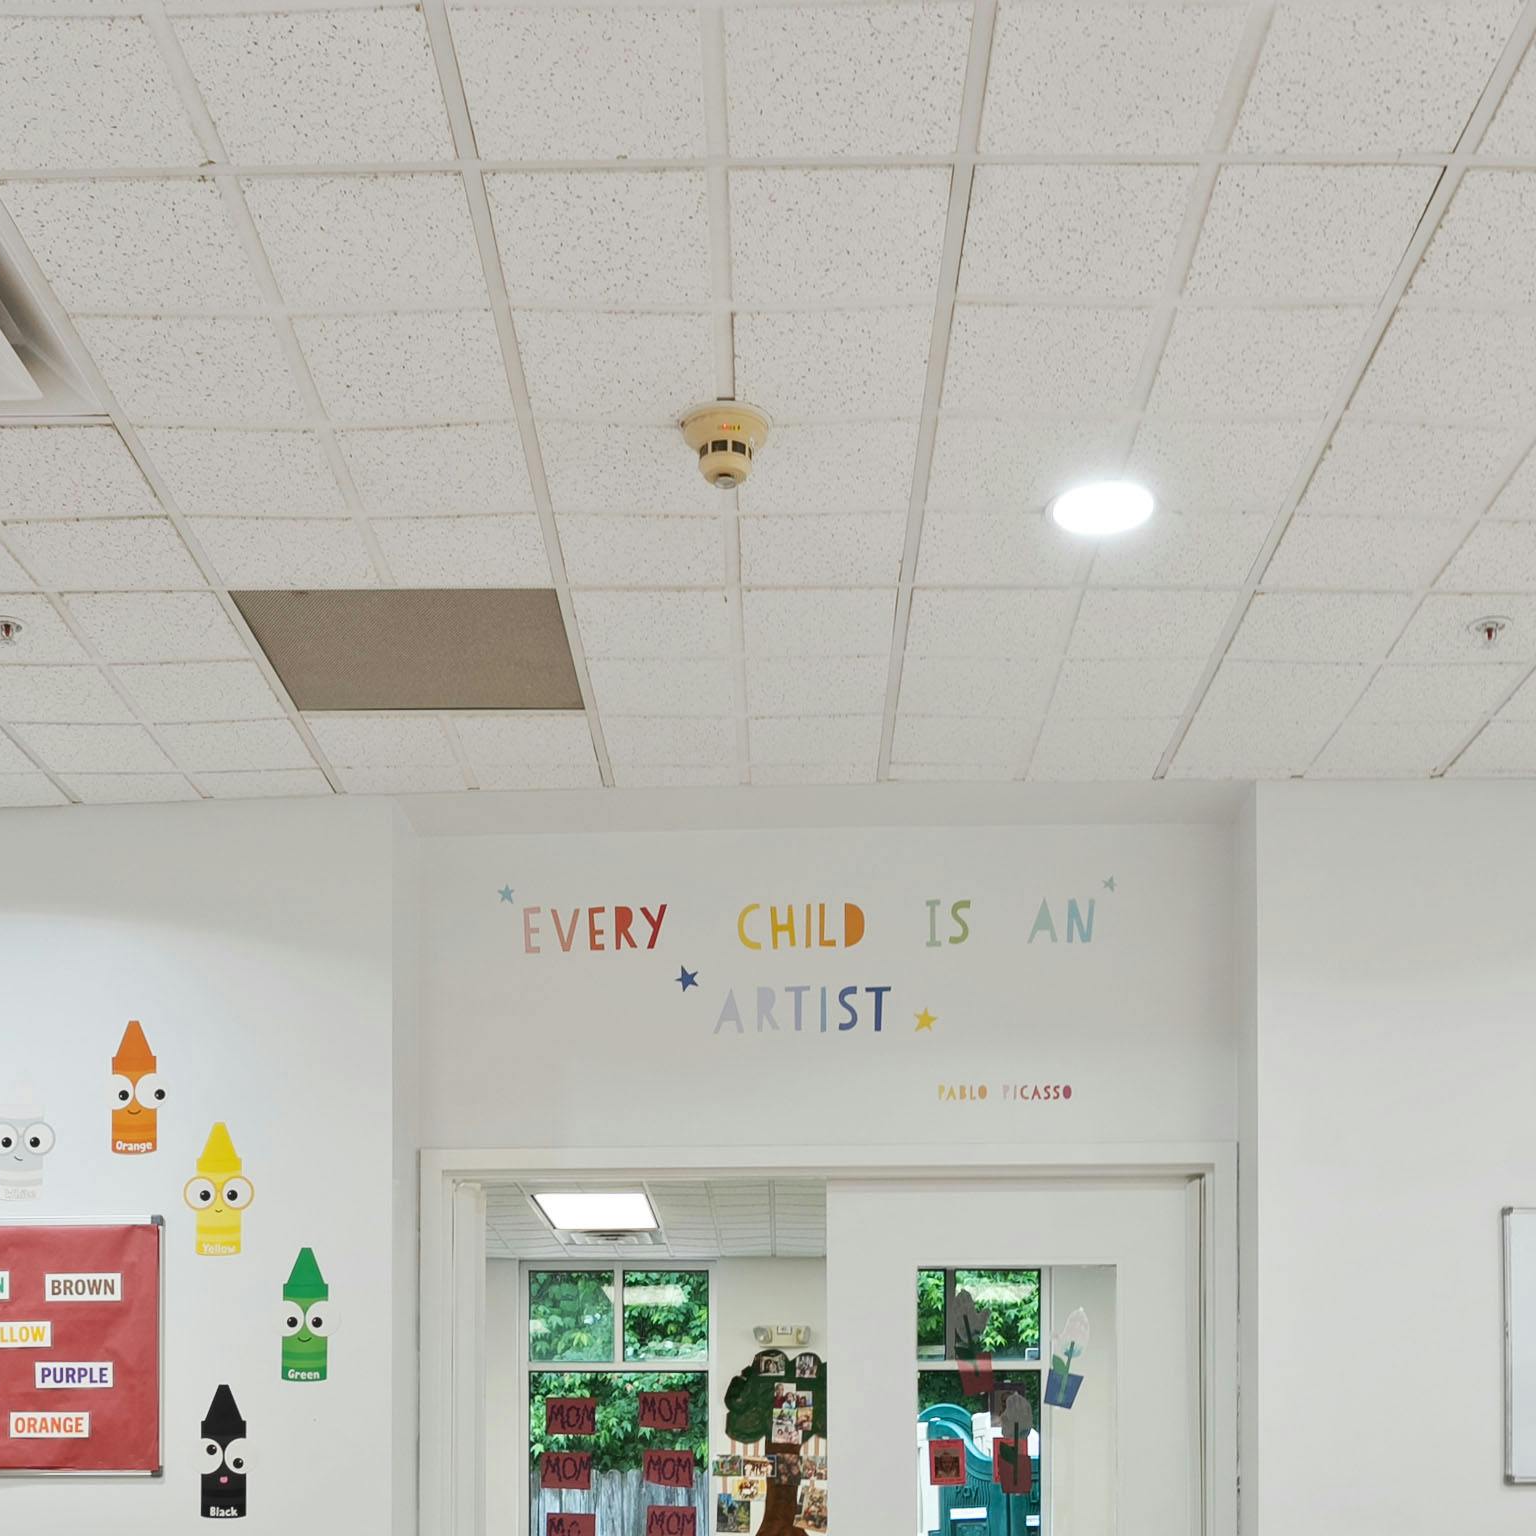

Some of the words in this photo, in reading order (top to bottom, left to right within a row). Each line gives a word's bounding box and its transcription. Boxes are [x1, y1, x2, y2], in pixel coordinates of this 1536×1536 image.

[522, 903, 668, 954] EVERY
[736, 901, 866, 951] CHILD
[925, 898, 972, 948] IS
[1027, 897, 1096, 944] AN
[712, 985, 892, 1034] ARTIST
[937, 1084, 989, 1101] PABLO
[1001, 1084, 1073, 1101] PICASSO
[115, 1140, 153, 1153] Orange
[202, 1242, 237, 1254] Yellow
[50, 1279, 116, 1297] BROWN
[40, 1367, 109, 1385] PURPLE
[287, 1368, 321, 1380] Green
[547, 1404, 596, 1433] MOM
[640, 1396, 689, 1425] MOM
[14, 1416, 85, 1434] ORANGE
[542, 1455, 592, 1483] MOM
[645, 1455, 694, 1484] MOM
[209, 1506, 239, 1517] Black
[648, 1510, 697, 1536] MOM
